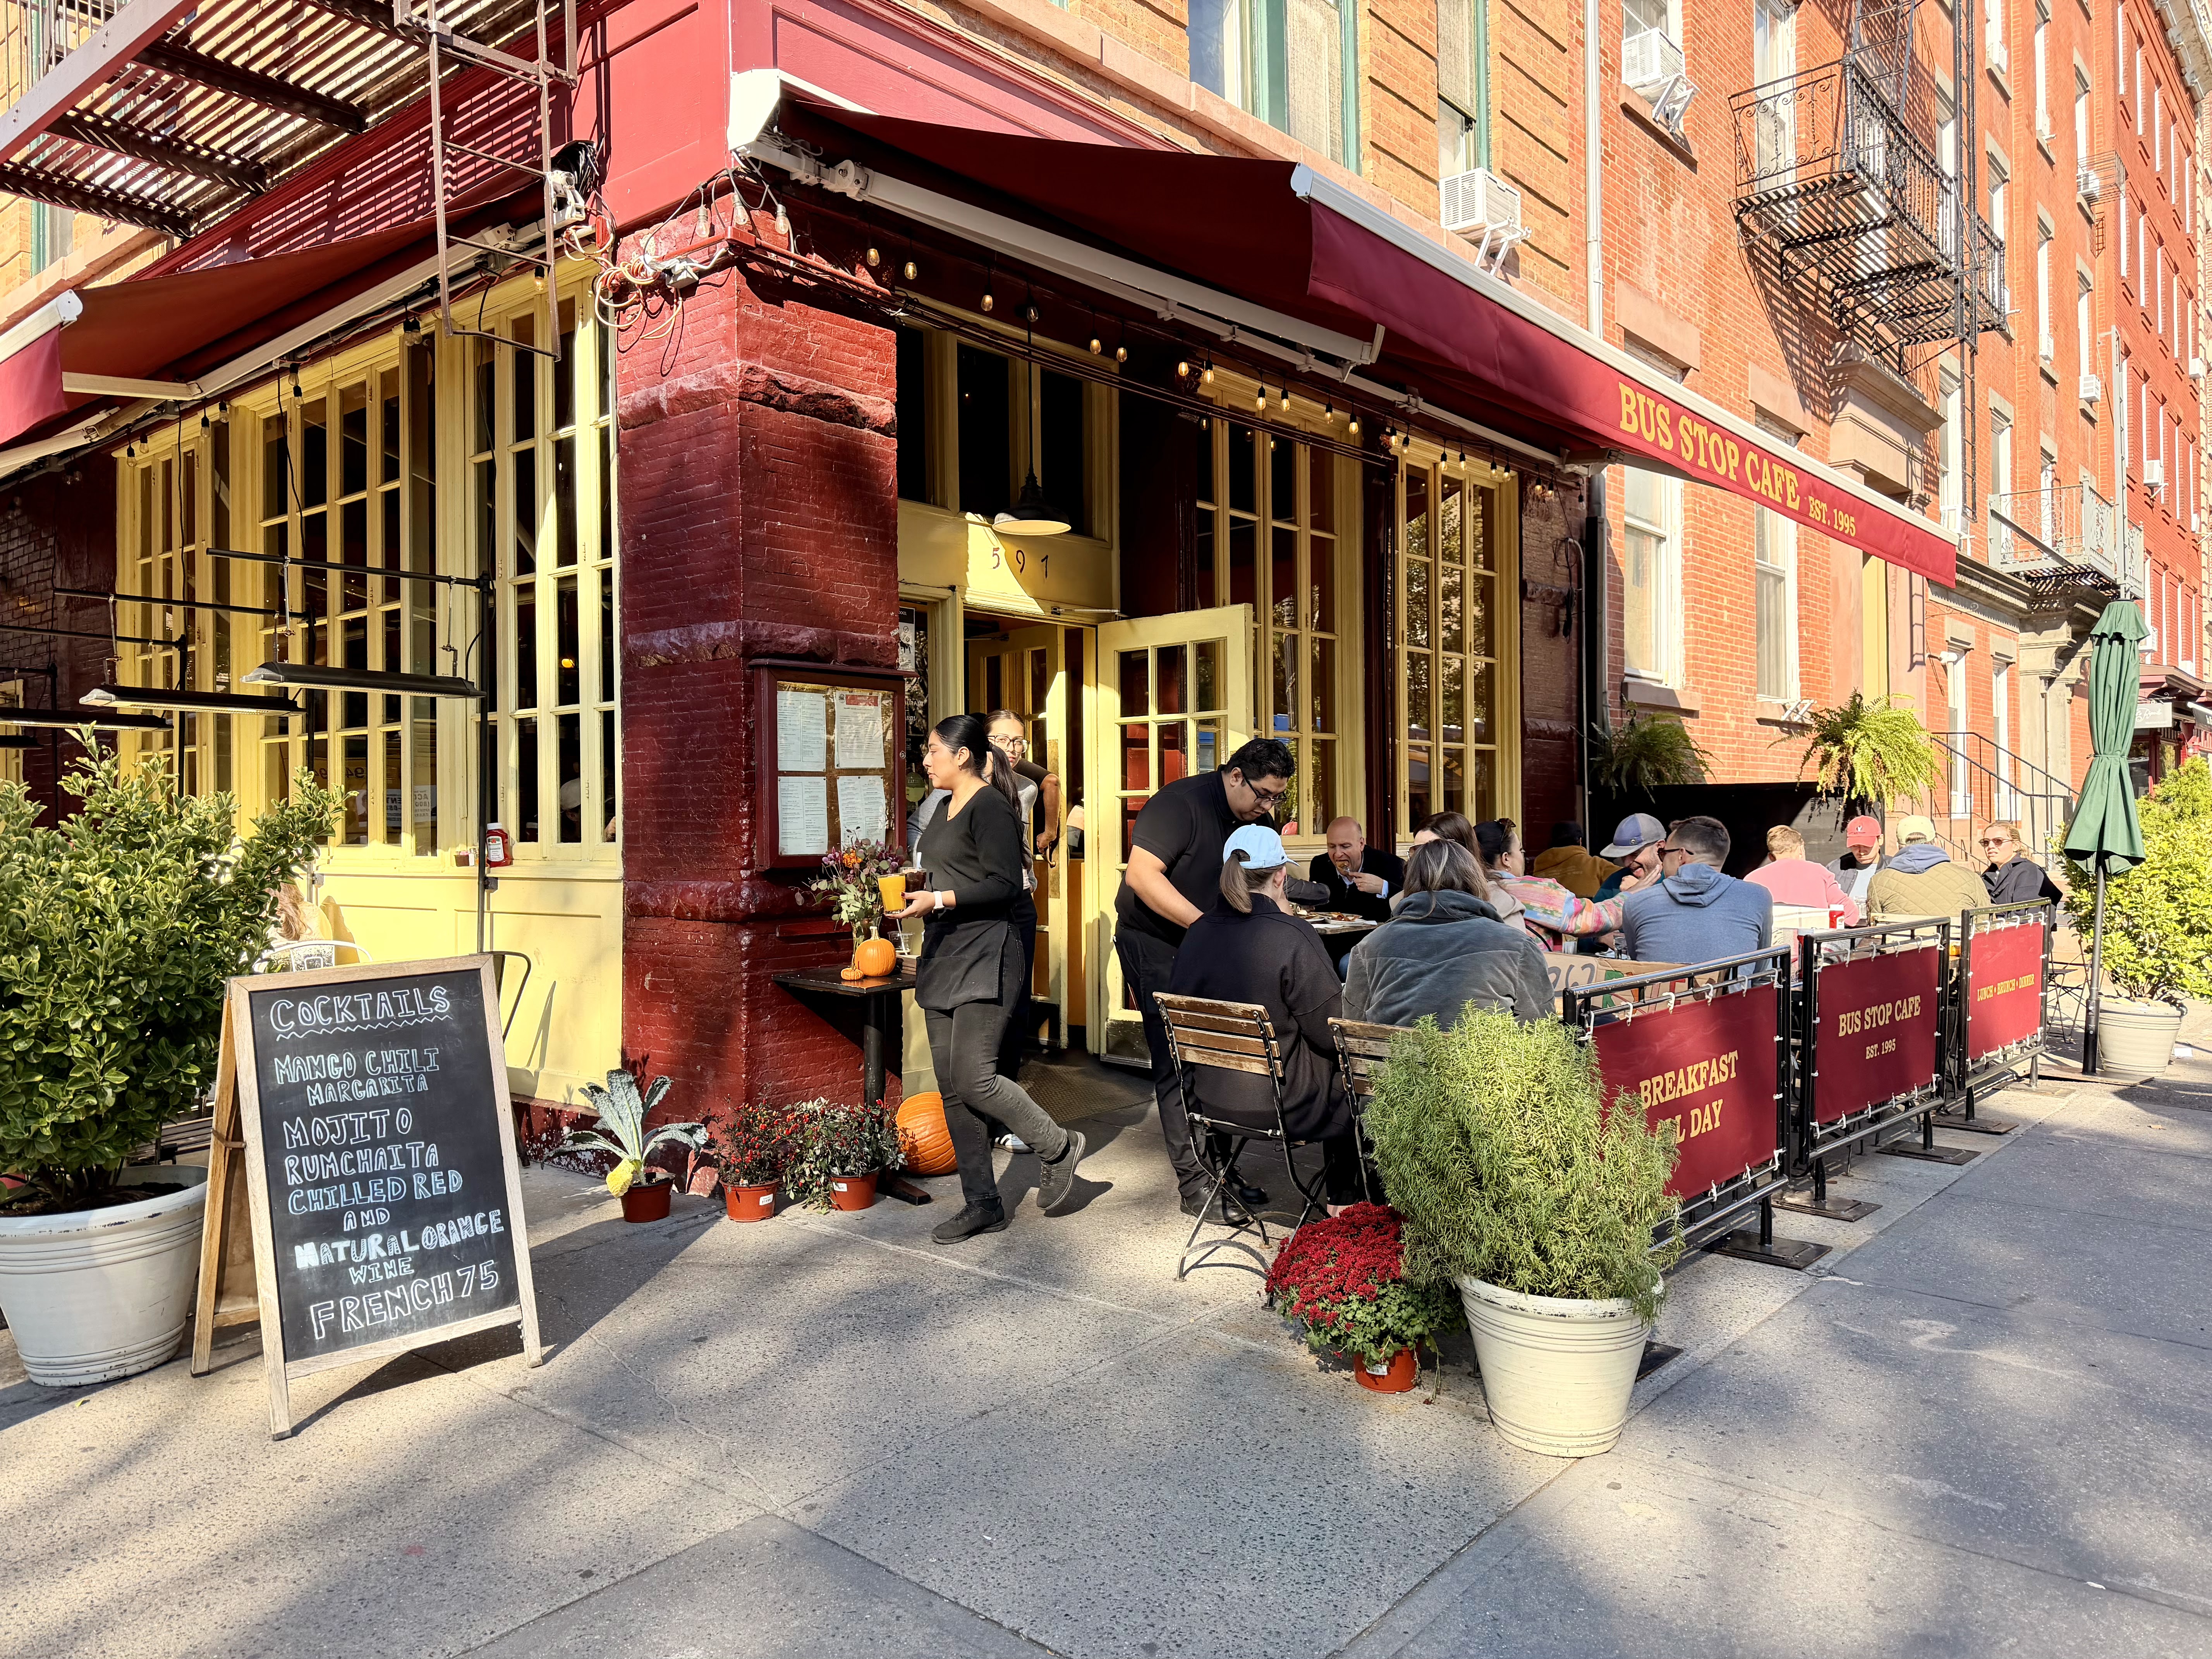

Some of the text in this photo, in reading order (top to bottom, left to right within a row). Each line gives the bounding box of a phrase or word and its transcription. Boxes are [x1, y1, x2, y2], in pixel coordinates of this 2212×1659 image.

[1618, 381, 1856, 537] BUS STOP CAFE EST. 1995
[1977, 973, 2035, 1002] LUNCH BRUNCH DINNER
[270, 986, 450, 1032] COCKTAILS
[1838, 994, 1921, 1037] BUS STOP CAFE
[274, 1048, 440, 1084] MANGO CHILI
[1865, 1038, 1896, 1060] EST. 1995
[306, 1073, 428, 1106] MARGARITA
[1639, 1049, 1738, 1110] BREAKFAST
[282, 1108, 412, 1149] MOJITO
[1690, 1099, 1723, 1138] DAY
[284, 1141, 439, 1185] RUMCHAITA
[288, 1170, 463, 1215] CHILLED RED
[294, 1209, 504, 1269] NATURAL ORANGE
[343, 1207, 390, 1231] AND
[349, 1257, 415, 1285] WINE
[310, 1259, 498, 1340] FRENCH 75
